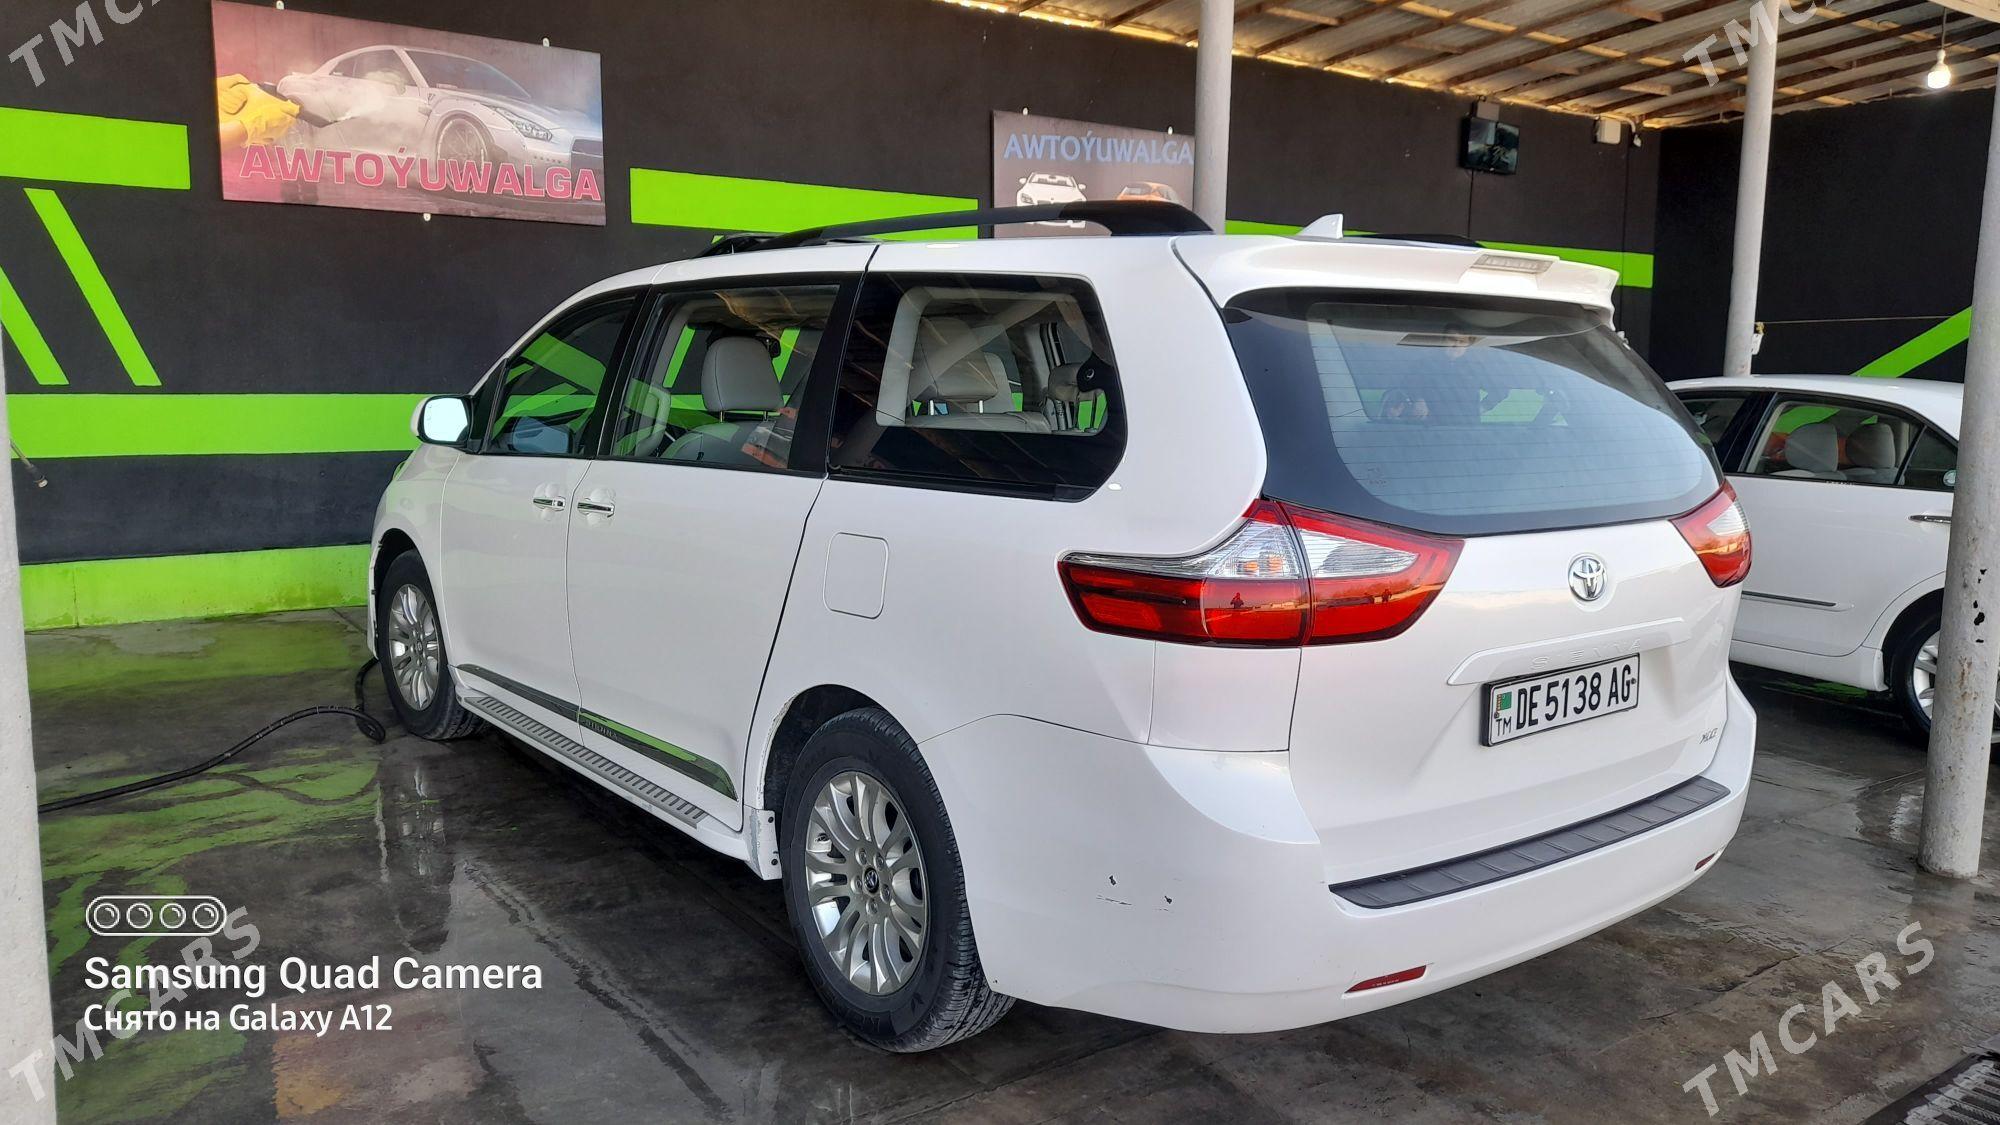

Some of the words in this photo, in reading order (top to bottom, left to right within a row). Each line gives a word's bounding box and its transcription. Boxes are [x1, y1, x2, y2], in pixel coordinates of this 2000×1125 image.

[1003, 130, 1194, 166] AWTOÝUWALGA
[239, 144, 602, 201] AWTOÝUWALGA
[1515, 684, 1542, 730] DE
[1544, 671, 1602, 721] 5138
[1607, 664, 1632, 707] AG
[1495, 716, 1512, 737] TM
